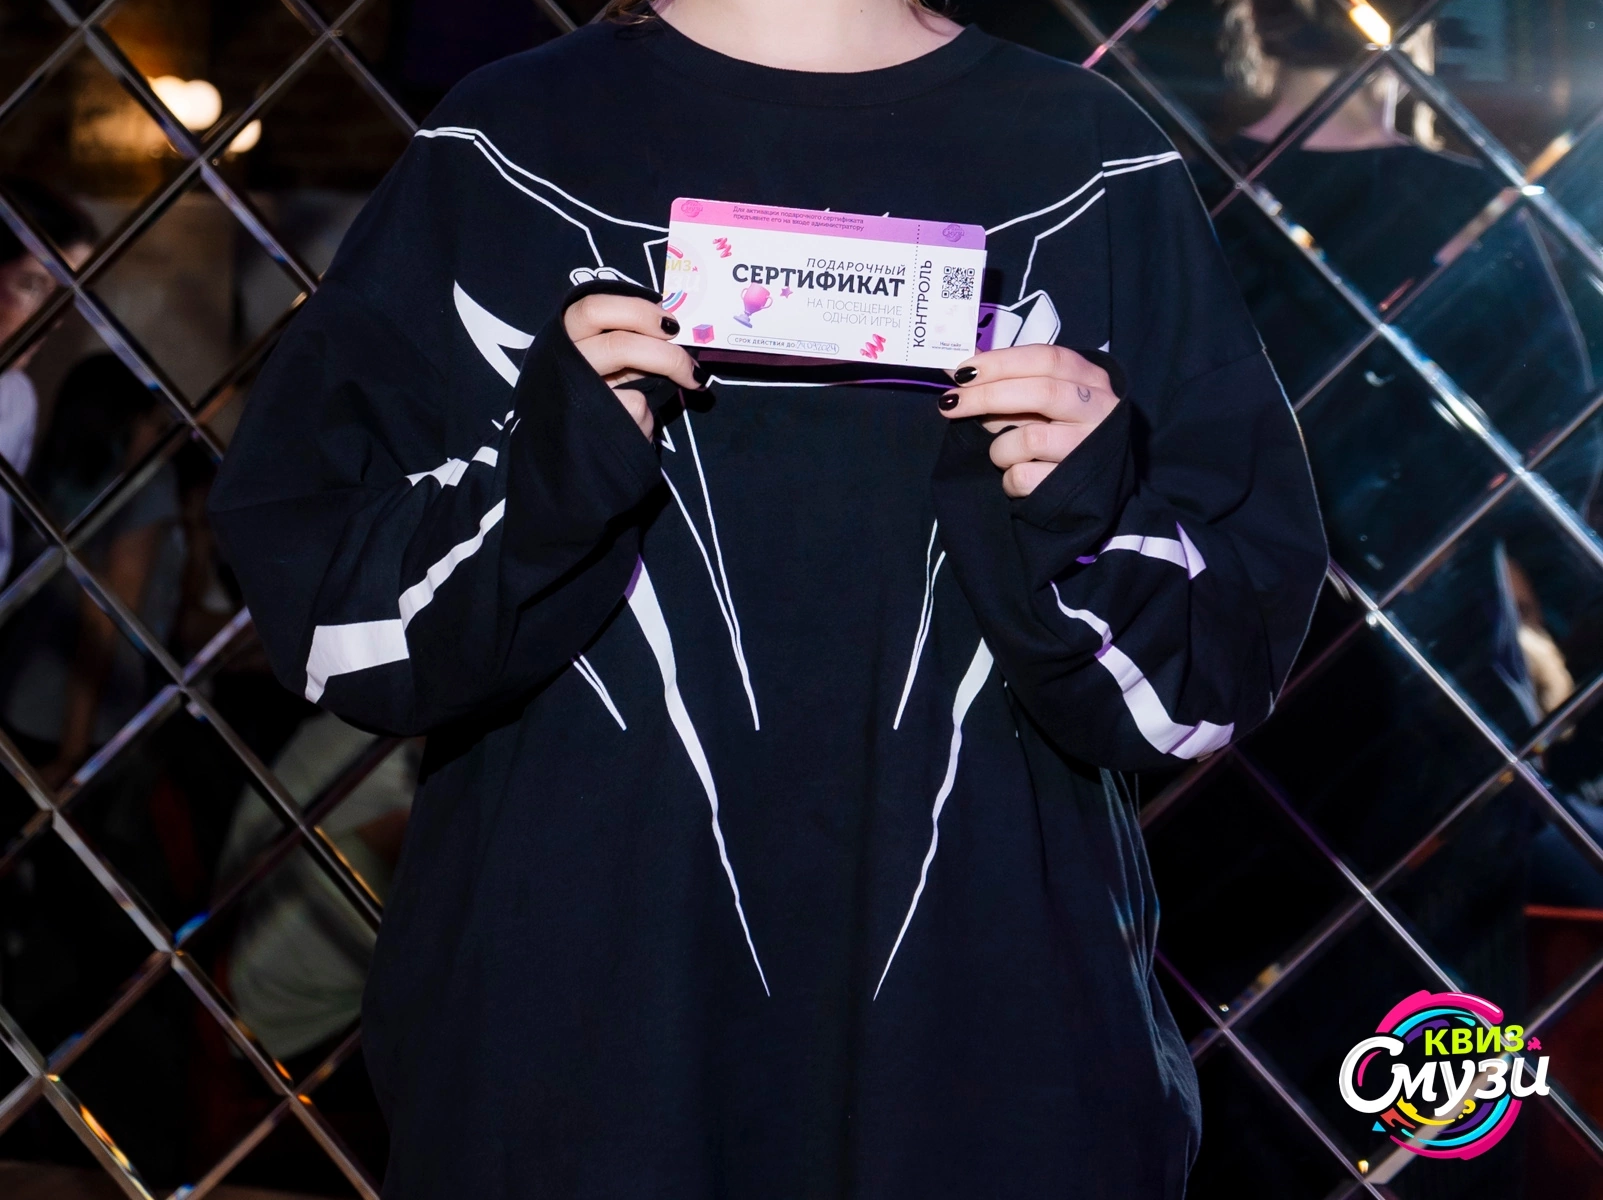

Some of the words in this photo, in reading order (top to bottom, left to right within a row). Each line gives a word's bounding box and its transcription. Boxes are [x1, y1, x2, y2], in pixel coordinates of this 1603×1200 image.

[732, 205, 746, 213] Для
[746, 208, 780, 216] активации
[780, 211, 822, 220] подарочного
[822, 214, 864, 224] сертификата
[733, 213, 770, 222] предъявите
[792, 219, 810, 227] входе
[811, 221, 865, 231] администратору
[806, 258, 906, 277] ПОДАРОЧНЫЙ
[732, 263, 905, 297] СЕРТИФИКАТ
[807, 298, 824, 308] НА
[826, 299, 903, 316] ПОСЕЩЕНИЕ
[913, 260, 933, 348] КОНТРОЛЬ
[822, 311, 867, 325] ОДНОЙ
[870, 317, 901, 328] ИГРЫ
[752, 338, 785, 347] ДЕЙСТВИЯ
